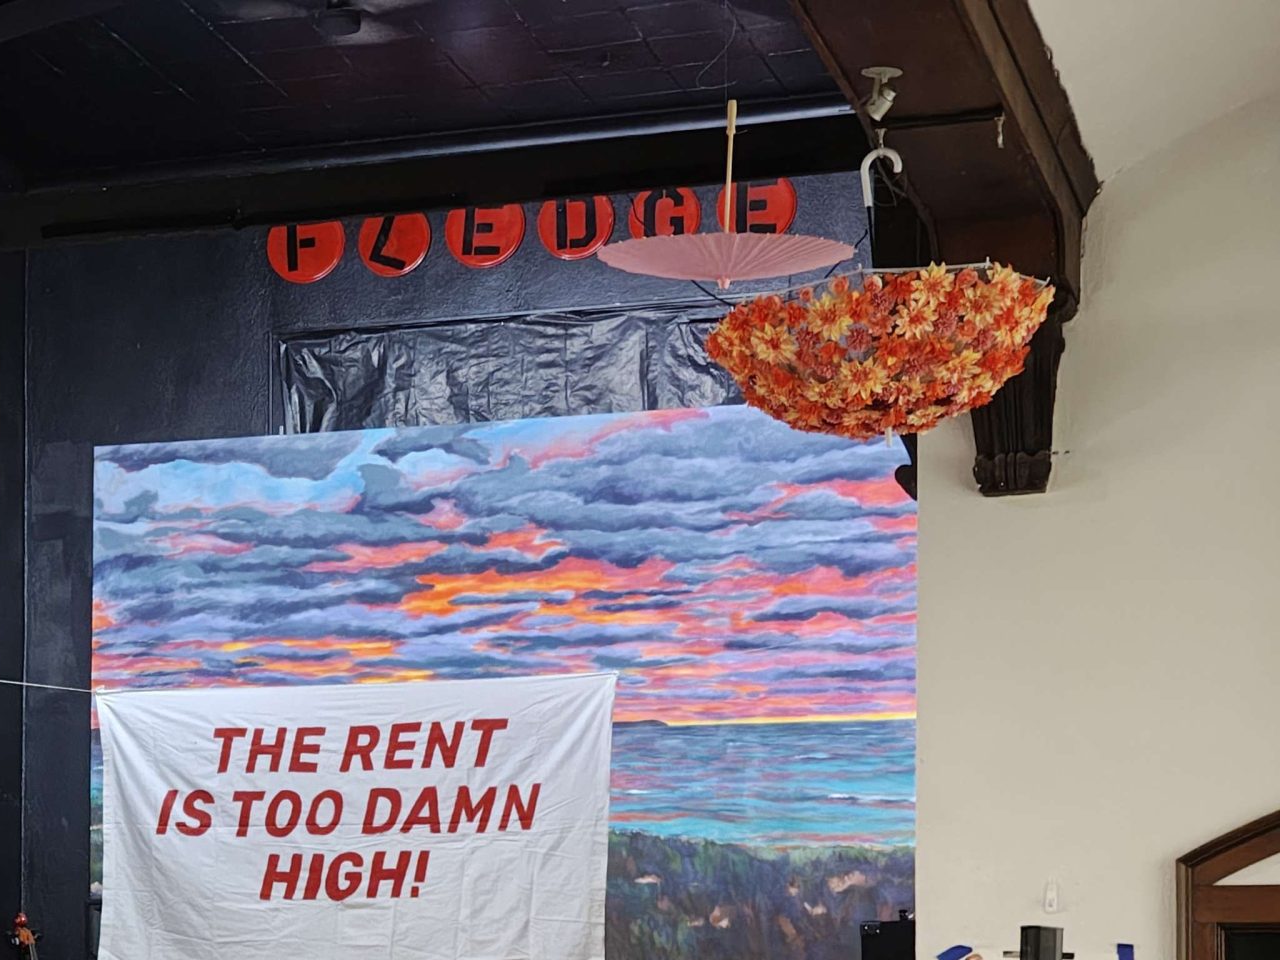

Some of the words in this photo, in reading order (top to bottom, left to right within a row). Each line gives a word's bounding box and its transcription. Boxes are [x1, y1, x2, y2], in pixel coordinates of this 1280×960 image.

[287, 178, 778, 272] FLEDGE
[213, 727, 326, 774] THE
[339, 718, 509, 773] RENT
[155, 789, 215, 837] IS
[232, 789, 344, 838] TOO
[361, 783, 542, 835] DAMN
[259, 850, 431, 901] HIGH!
